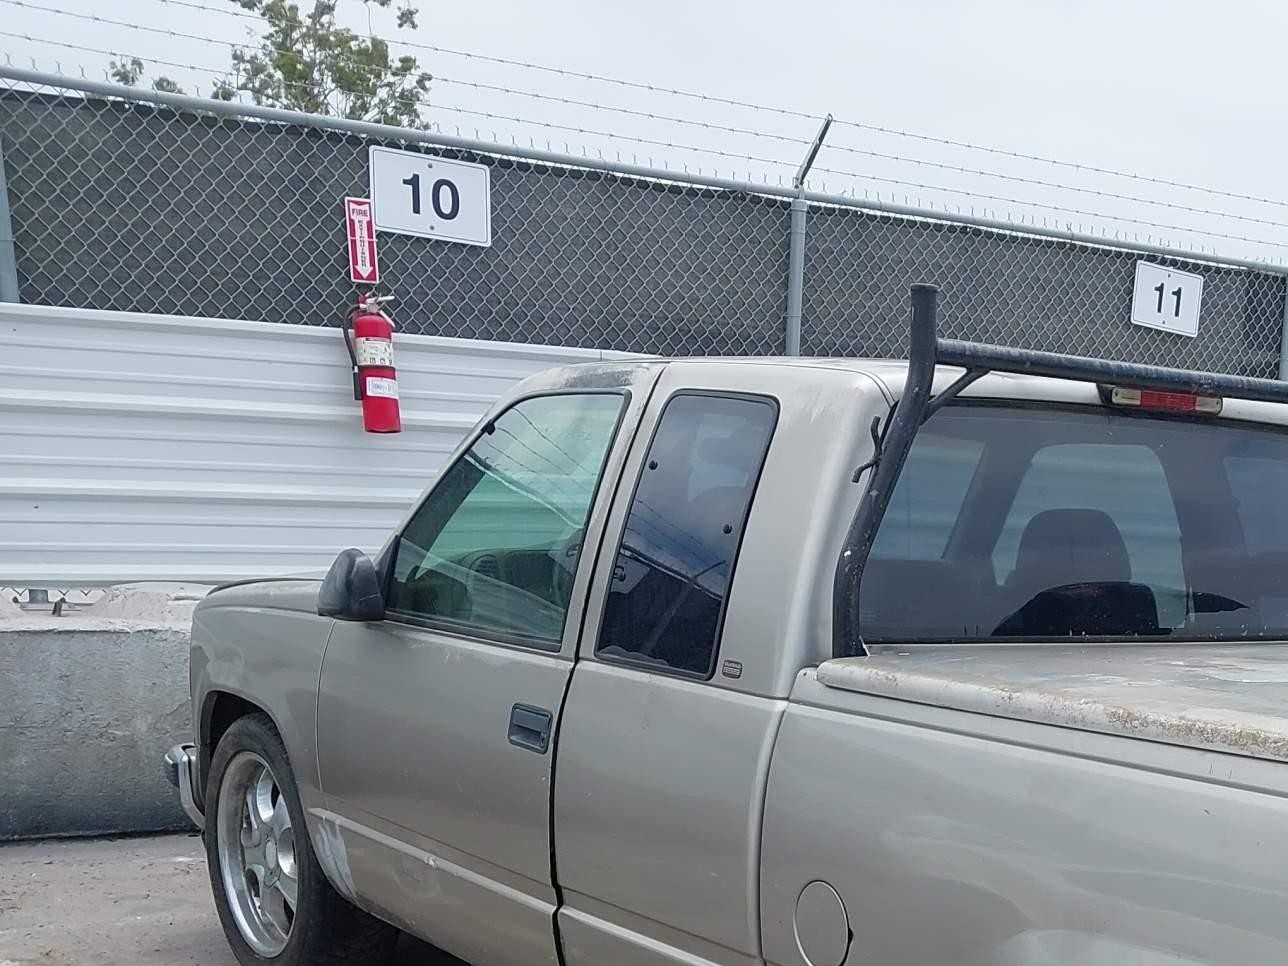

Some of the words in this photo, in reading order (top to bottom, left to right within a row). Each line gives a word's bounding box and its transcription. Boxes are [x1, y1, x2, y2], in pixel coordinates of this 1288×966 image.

[351, 208, 369, 218] FIRE
[402, 173, 460, 221] 10
[1154, 282, 1182, 318] 11
